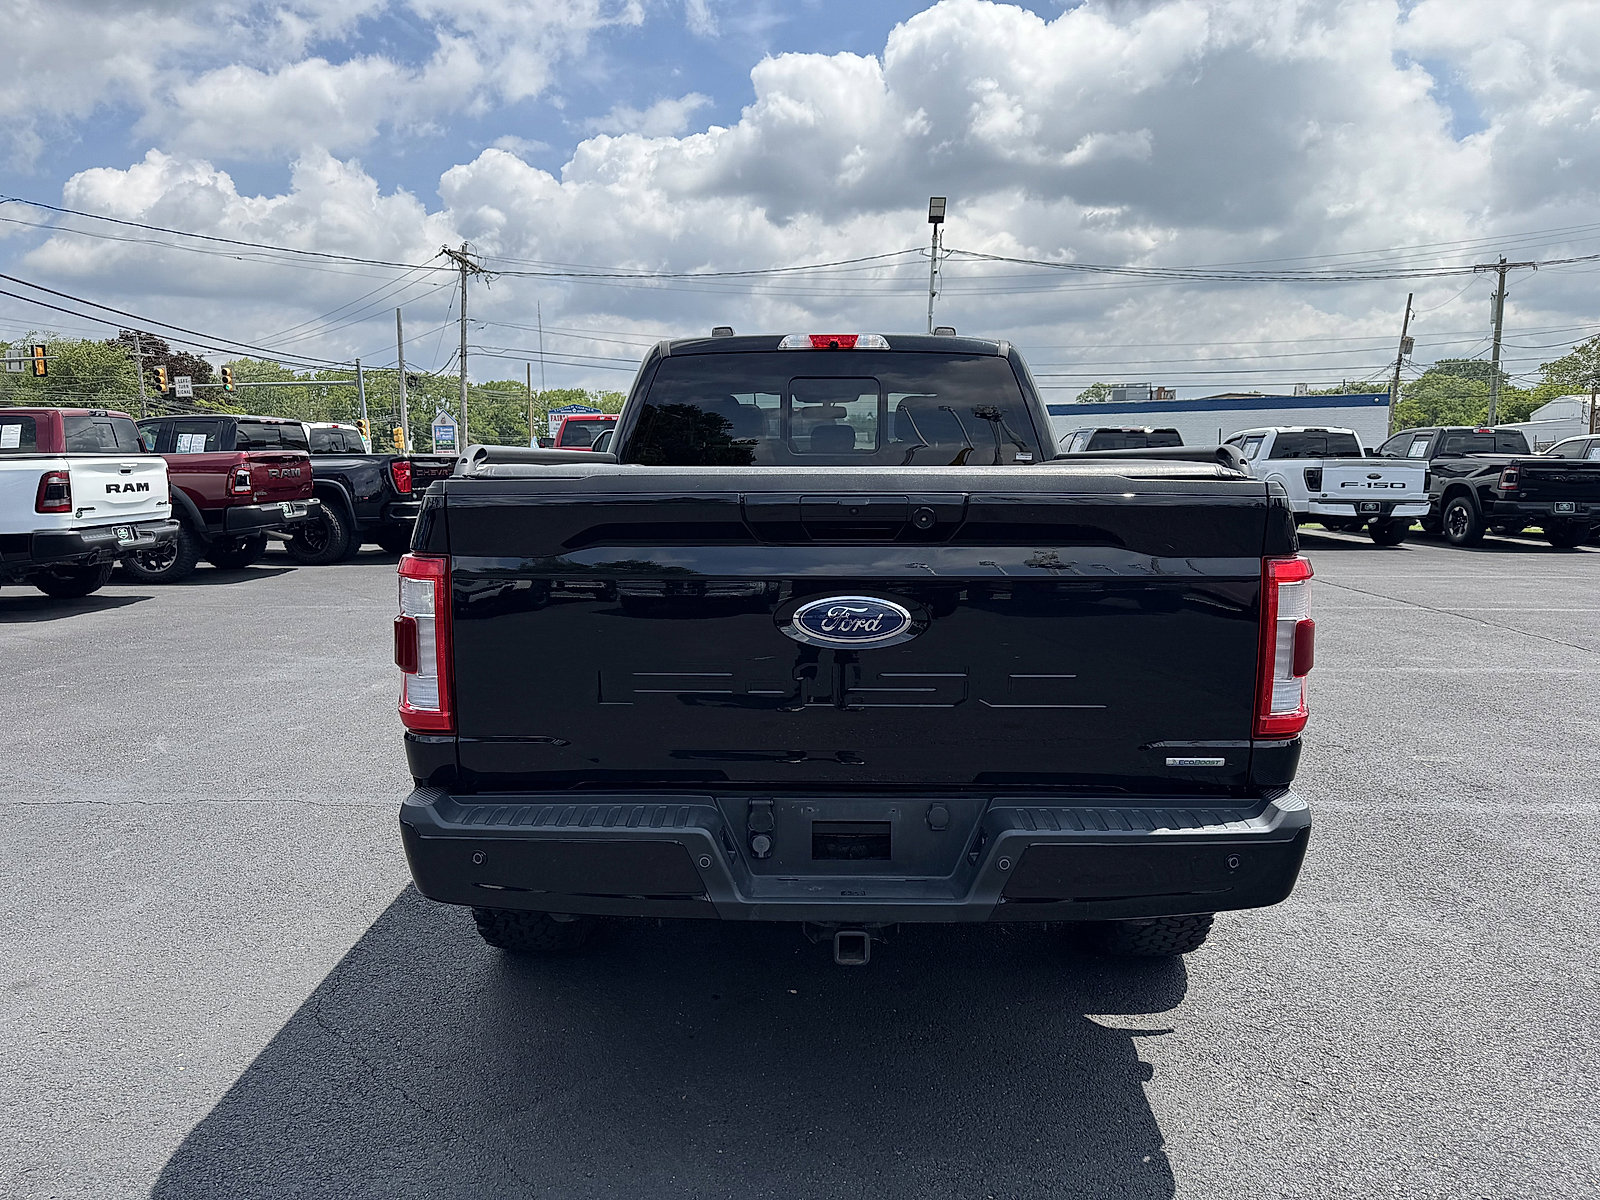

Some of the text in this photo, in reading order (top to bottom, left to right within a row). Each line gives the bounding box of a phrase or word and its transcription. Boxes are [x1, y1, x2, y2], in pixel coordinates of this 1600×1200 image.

[268, 467, 301, 479] RAM
[105, 482, 149, 494] RAM
[1340, 481, 1406, 489] F-150
[821, 605, 884, 632] Ford
